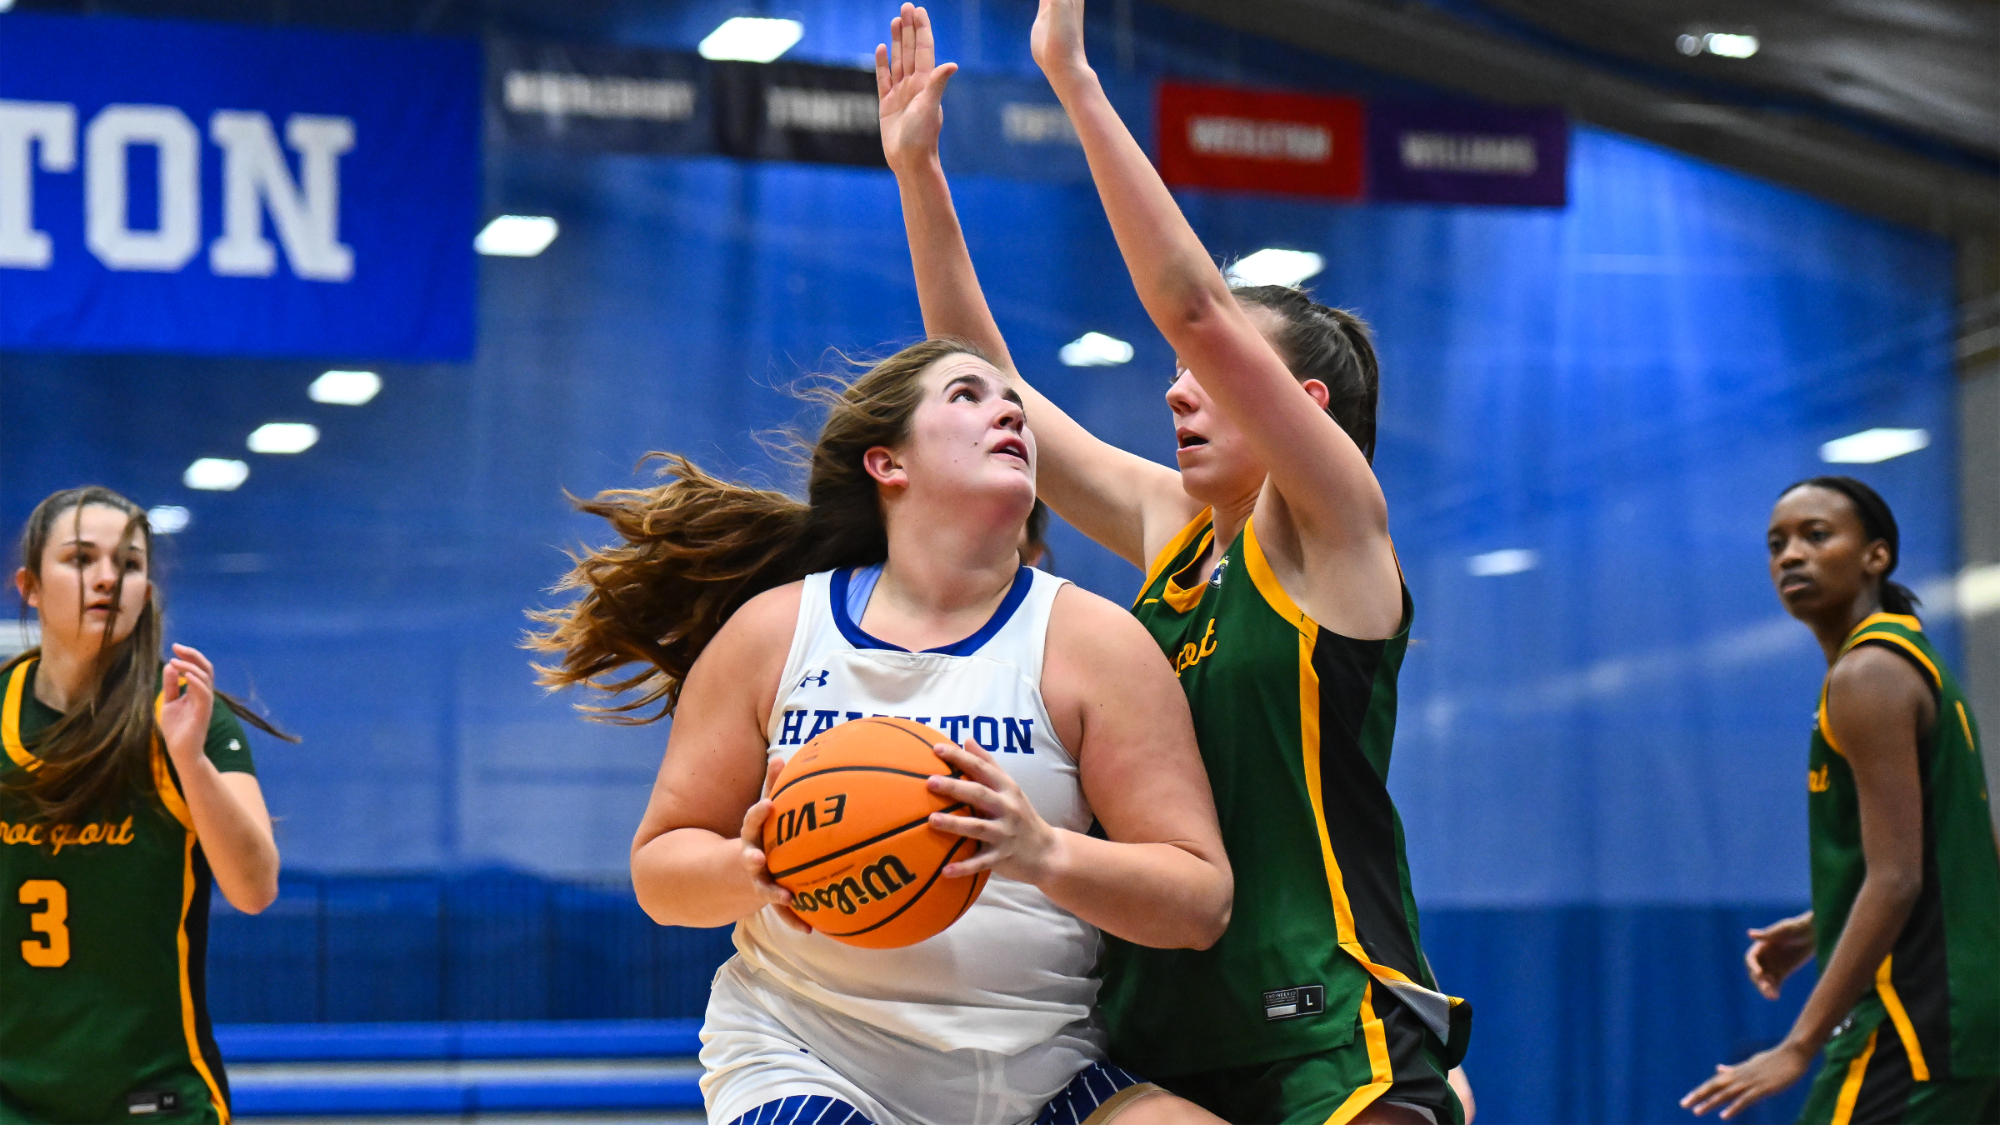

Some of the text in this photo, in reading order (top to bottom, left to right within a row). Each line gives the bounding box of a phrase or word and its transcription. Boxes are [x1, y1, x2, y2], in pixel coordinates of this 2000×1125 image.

[0, 99, 355, 283] TON
[779, 709, 1035, 754] HATON
[776, 793, 847, 846] EVO
[19, 879, 70, 968] 3
[1306, 994, 1313, 1006] L
